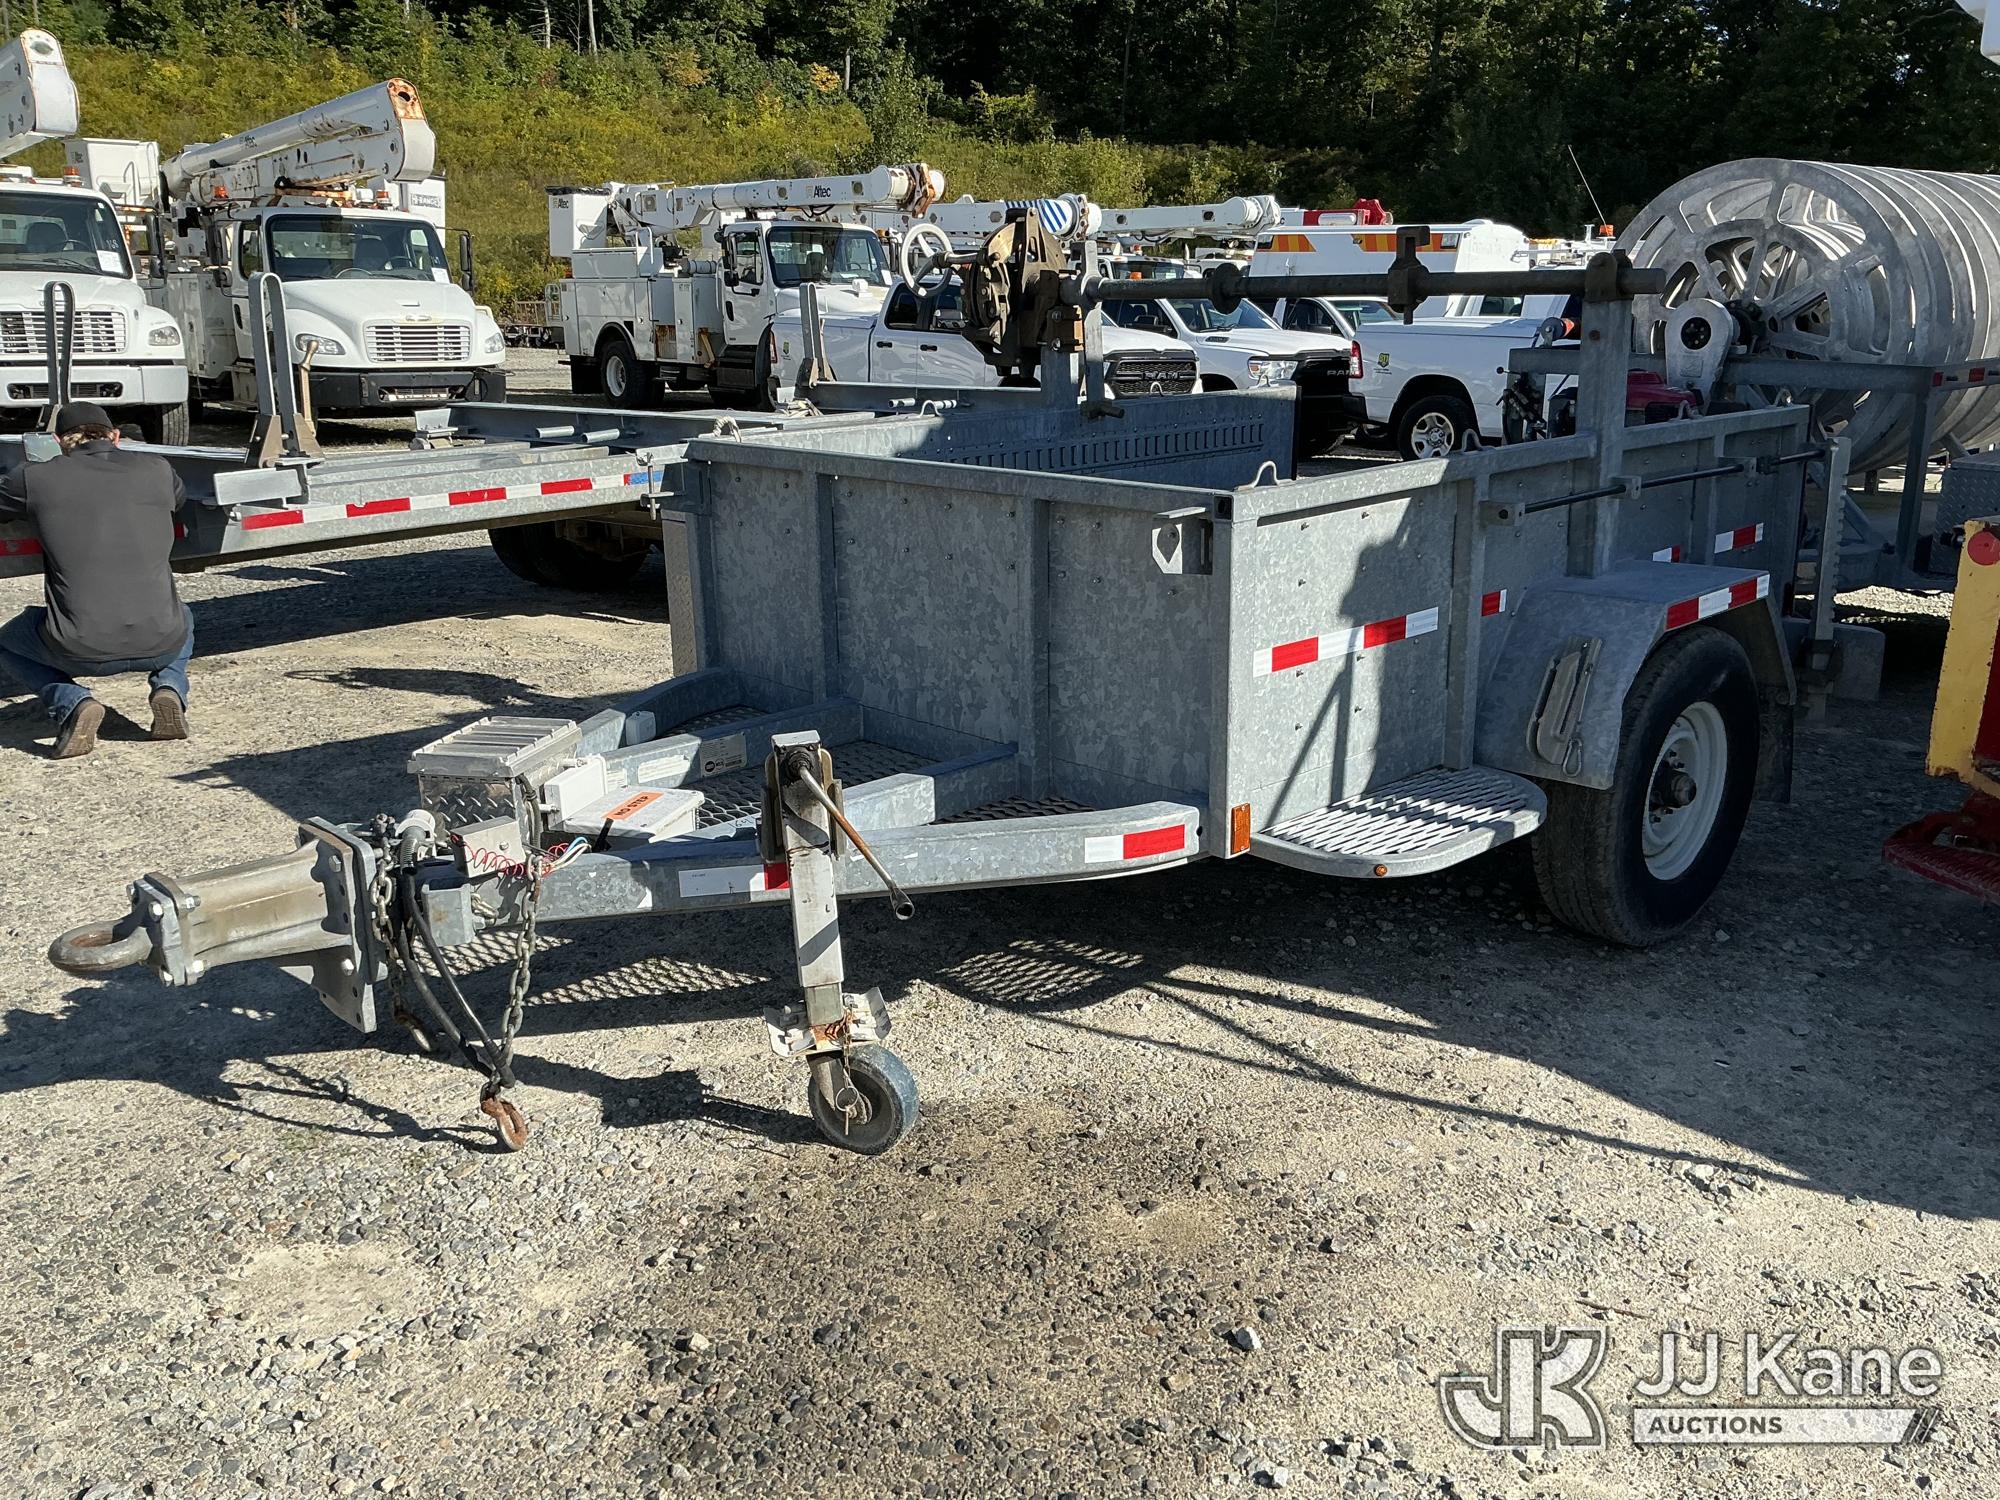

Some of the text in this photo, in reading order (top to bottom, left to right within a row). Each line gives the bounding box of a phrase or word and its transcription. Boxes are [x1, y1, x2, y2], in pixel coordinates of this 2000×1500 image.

[813, 185, 831, 198] Altec
[1144, 370, 1178, 380] RAM
[614, 795, 649, 816] NO STEP
